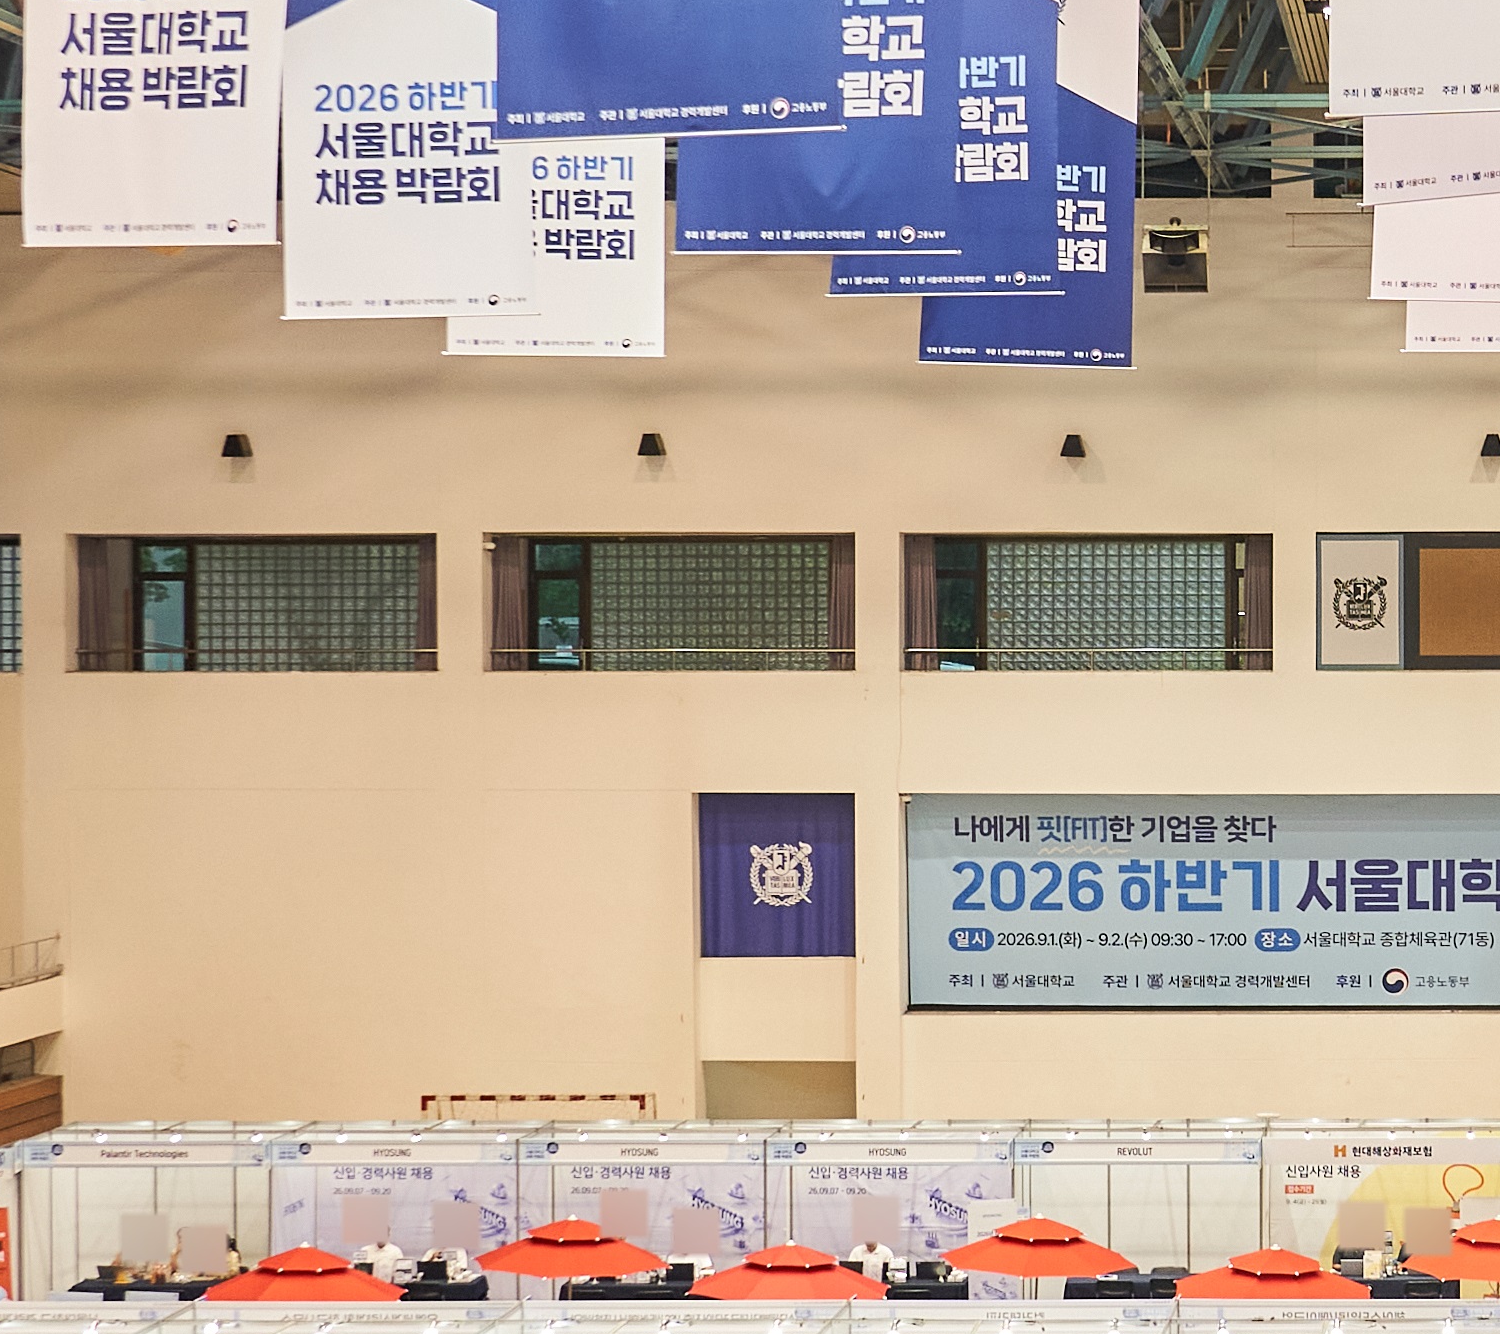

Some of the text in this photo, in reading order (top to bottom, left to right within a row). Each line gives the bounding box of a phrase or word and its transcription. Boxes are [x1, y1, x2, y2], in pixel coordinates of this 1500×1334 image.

[1342, 86, 1360, 99] 주최
[1384, 87, 1424, 96] 서울대학교
[1443, 85, 1458, 95] 주관
[955, 815, 1276, 842] 나에게 핏[FIT]한 기업을 찾다
[953, 861, 1103, 911] 2026
[1119, 859, 1279, 912] 하반기
[954, 931, 1494, 949] 일시 2026.9.1.(화) 9.2.(수) 09:30 17:00 장소 서울대학교 종합체육관(71동)
[949, 974, 1469, 988] 주최 서울대학교 주관 서울대학교 경력개발센터 후원 고용노동부
[101, 1150, 188, 1159] Palantir Technologies
[373, 1149, 411, 1157] HYOSUNG
[1117, 1148, 1152, 1156] REVOLUT
[1353, 1146, 1432, 1157] 현대해상화재보험
[411, 1167, 432, 1180] 채용
[1286, 1165, 1361, 1178] 신입사원 채용
